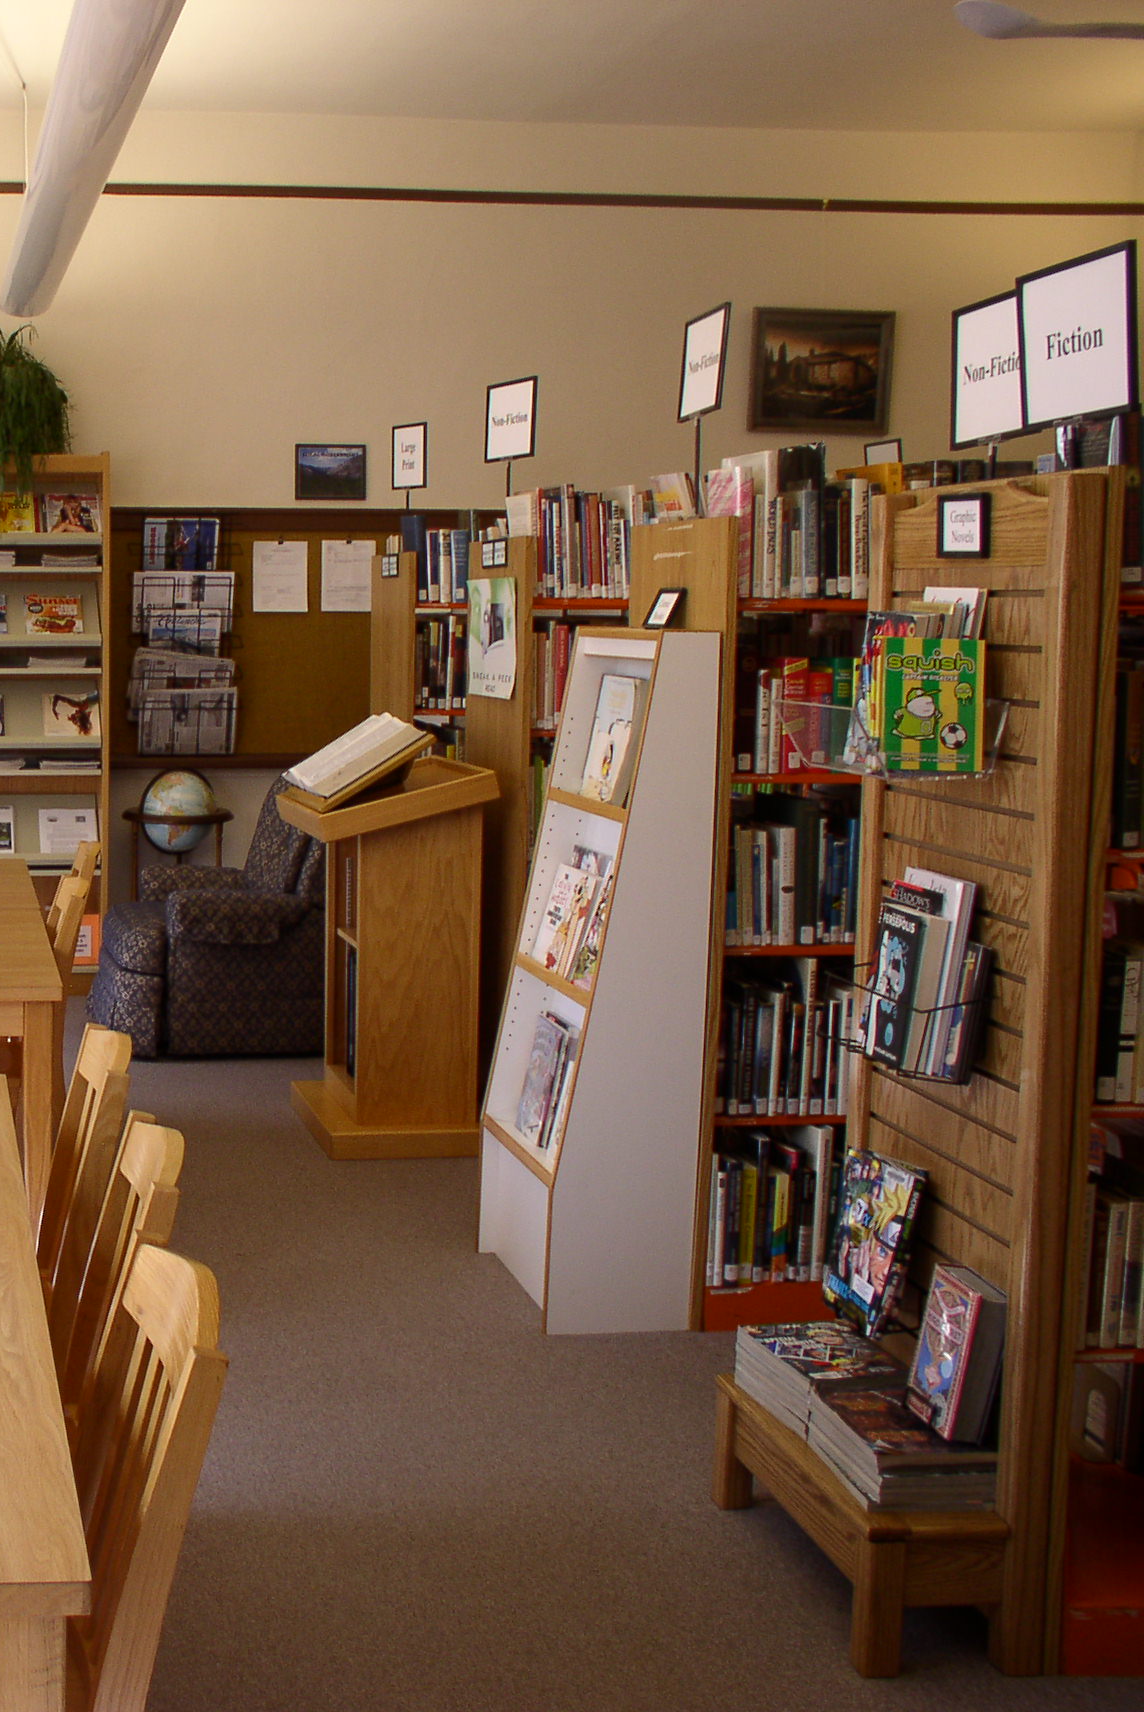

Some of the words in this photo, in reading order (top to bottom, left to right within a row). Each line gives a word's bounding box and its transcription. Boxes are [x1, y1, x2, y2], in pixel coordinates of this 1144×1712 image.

[1046, 326, 1104, 361] Fiction
[688, 352, 720, 375] Non-Fiction
[963, 351, 1020, 385] Non-Fictio
[491, 411, 529, 427] Non-Fiction
[401, 442, 416, 455] Large
[402, 459, 415, 470] Print
[950, 510, 976, 526] Graphic
[952, 530, 974, 543] Novels
[887, 648, 974, 673] squish
[883, 912, 916, 934] PERSEPOLIS
